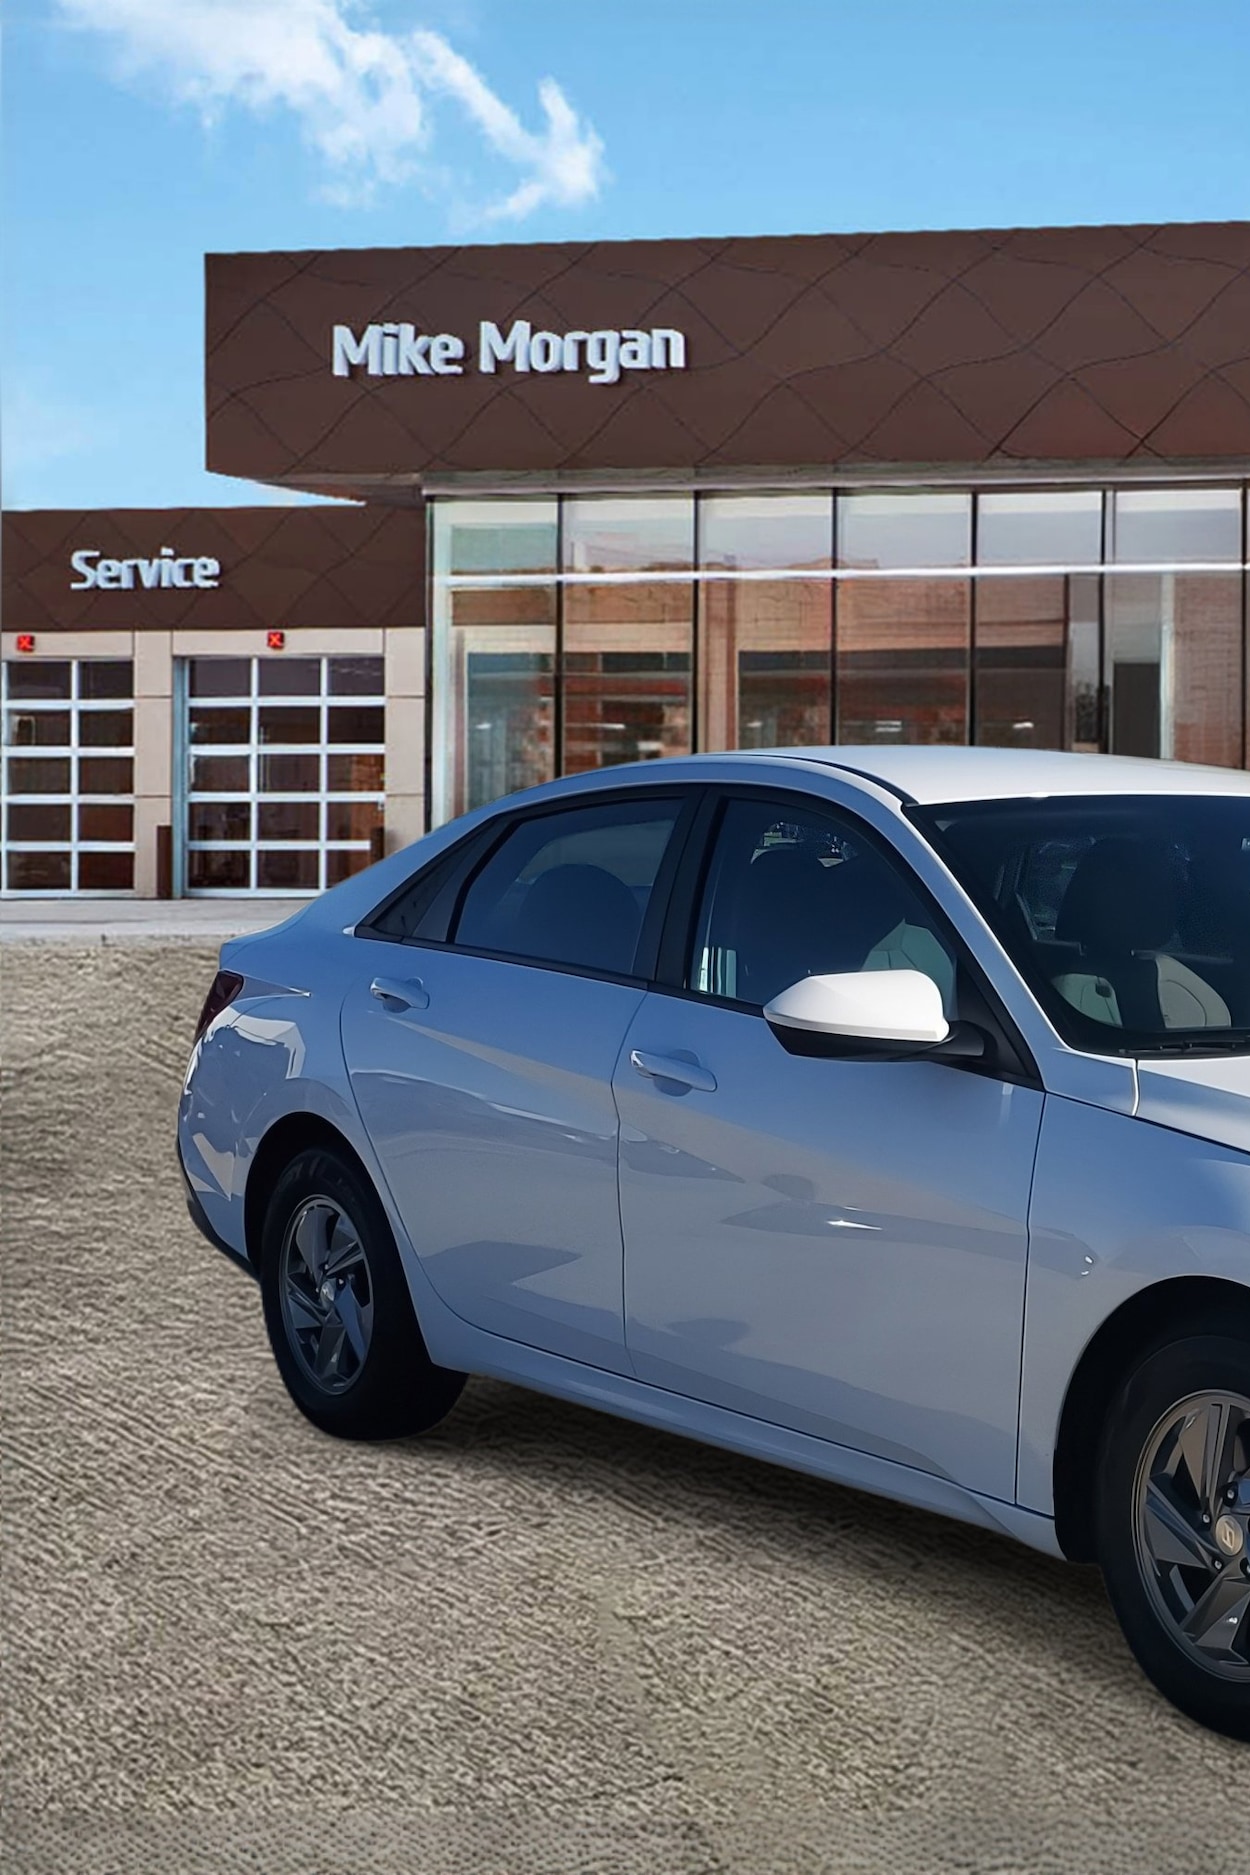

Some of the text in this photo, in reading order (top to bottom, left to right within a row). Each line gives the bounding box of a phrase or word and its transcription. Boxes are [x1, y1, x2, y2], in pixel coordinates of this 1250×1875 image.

[332, 320, 686, 384] Mike Morgan
[70, 547, 221, 590] Service
